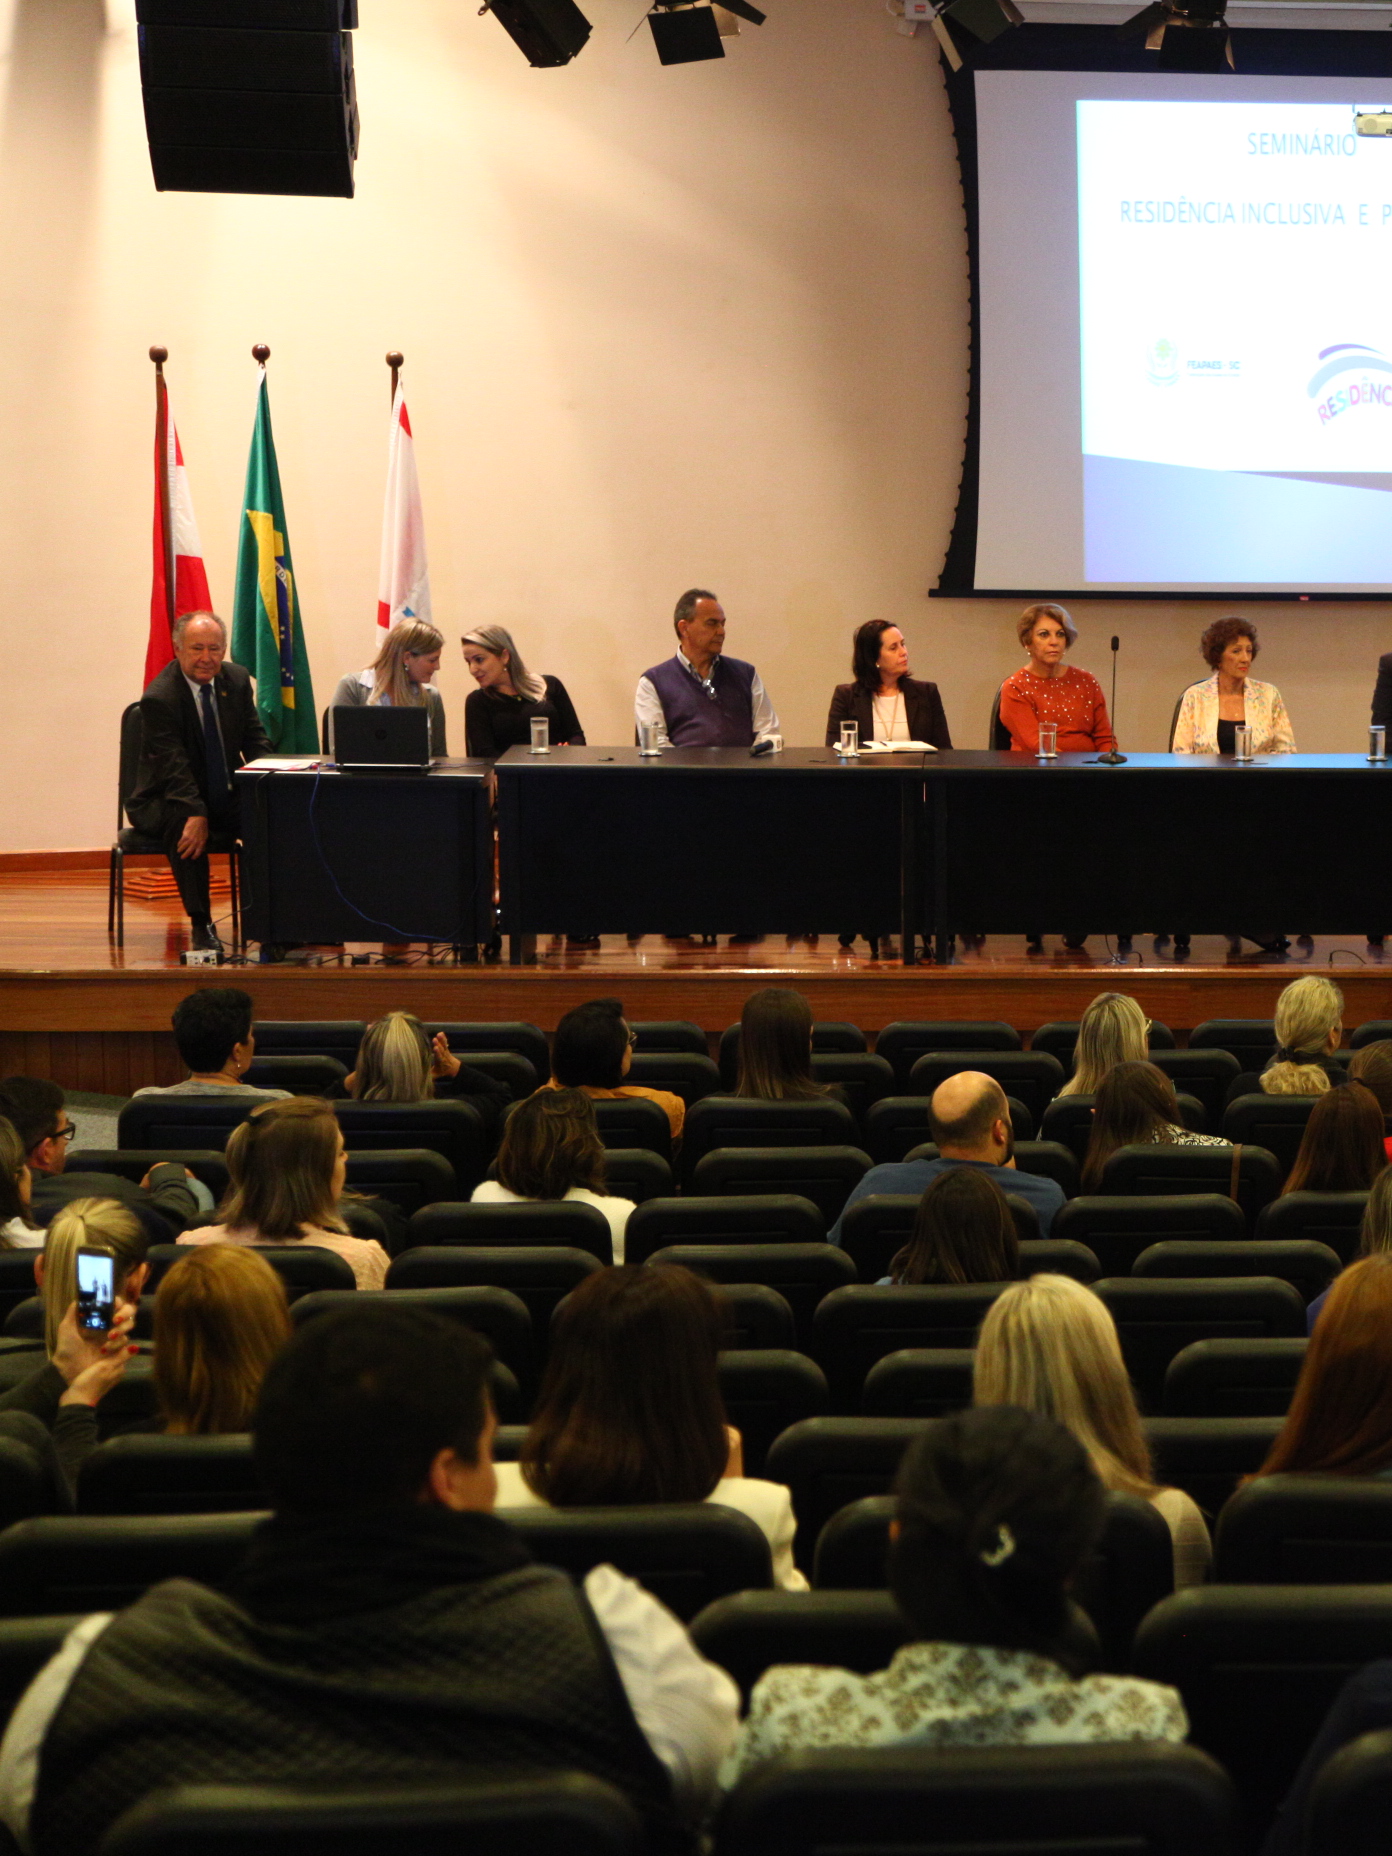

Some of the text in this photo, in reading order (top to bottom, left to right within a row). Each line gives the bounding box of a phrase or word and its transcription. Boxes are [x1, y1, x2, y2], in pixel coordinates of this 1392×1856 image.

[1247, 127, 1357, 156] SEMINÁRIO
[1120, 195, 1236, 224] RESIDÊNCIA
[1242, 202, 1346, 225] INCLUSIVA
[1358, 203, 1369, 226] E
